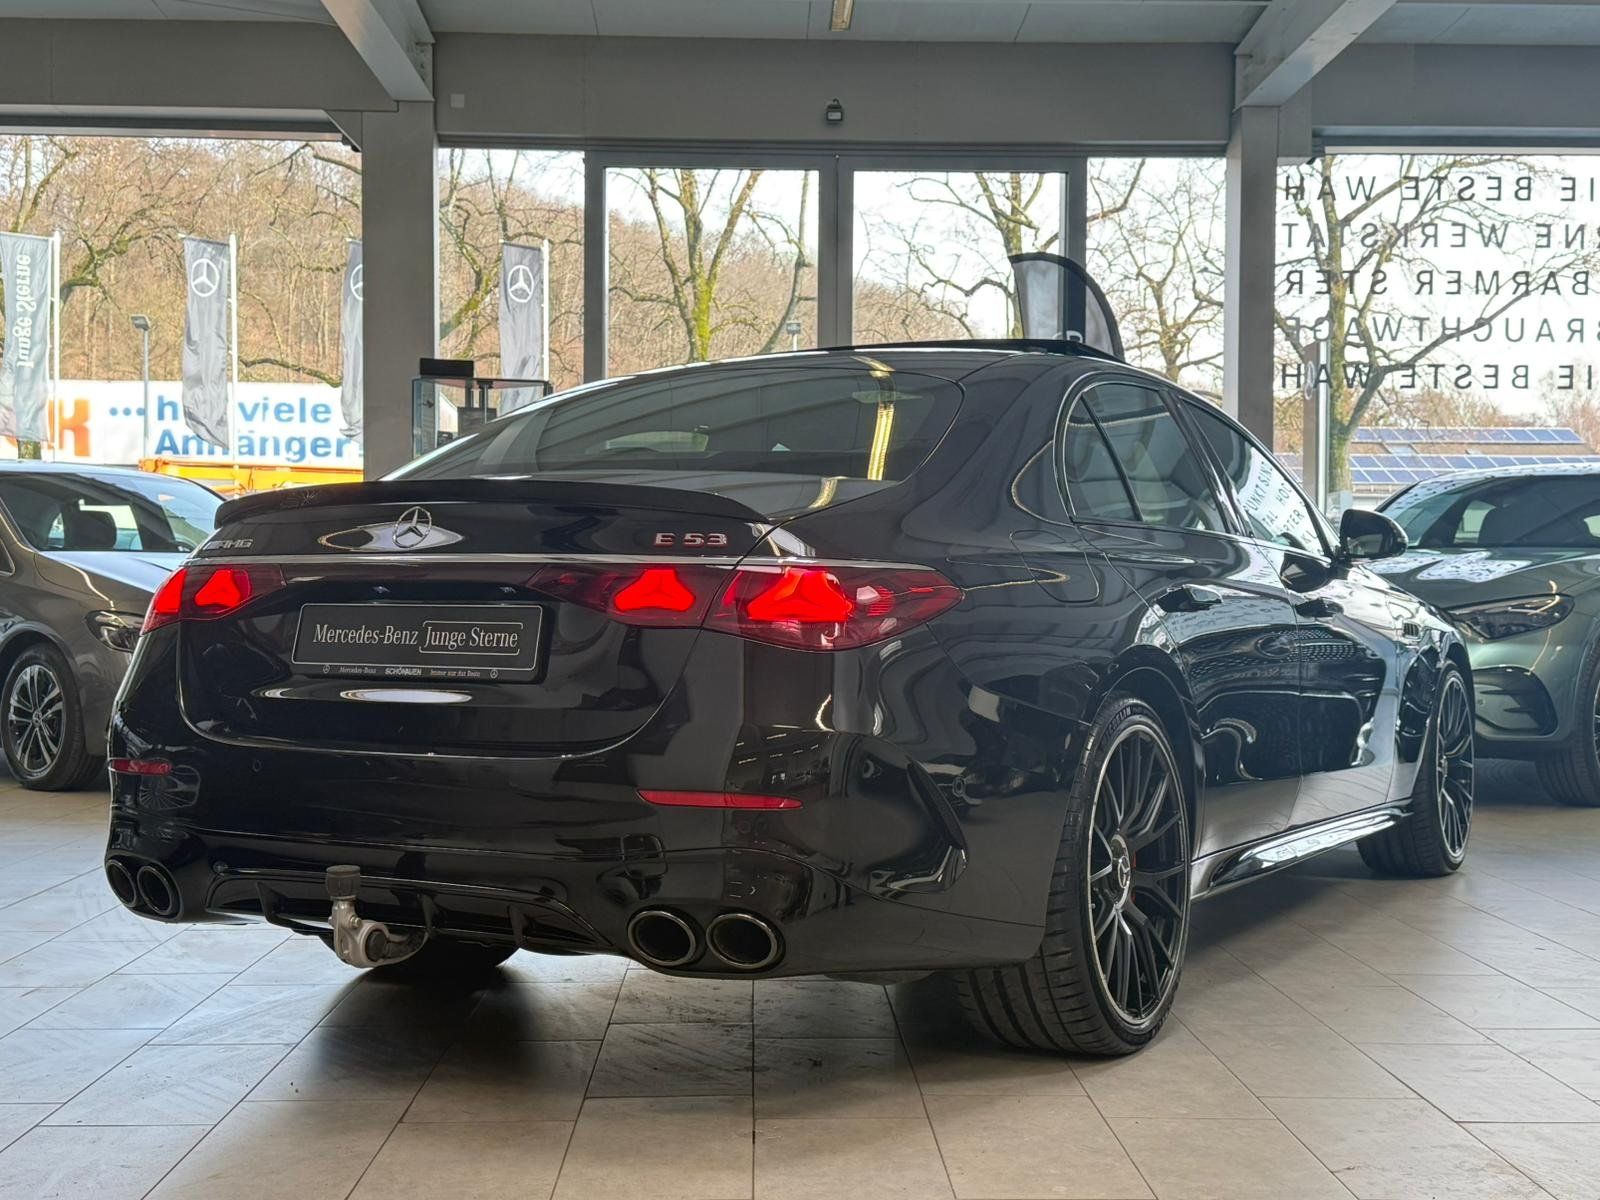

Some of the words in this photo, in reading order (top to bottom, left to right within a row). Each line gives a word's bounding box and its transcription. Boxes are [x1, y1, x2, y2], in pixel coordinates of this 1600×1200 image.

[237, 396, 333, 424] viele
[654, 532, 676, 548] E
[683, 532, 728, 548] 53
[312, 624, 418, 646] Mercedes-Benz
[423, 626, 466, 650] Junge
[469, 626, 519, 648] Sterne
